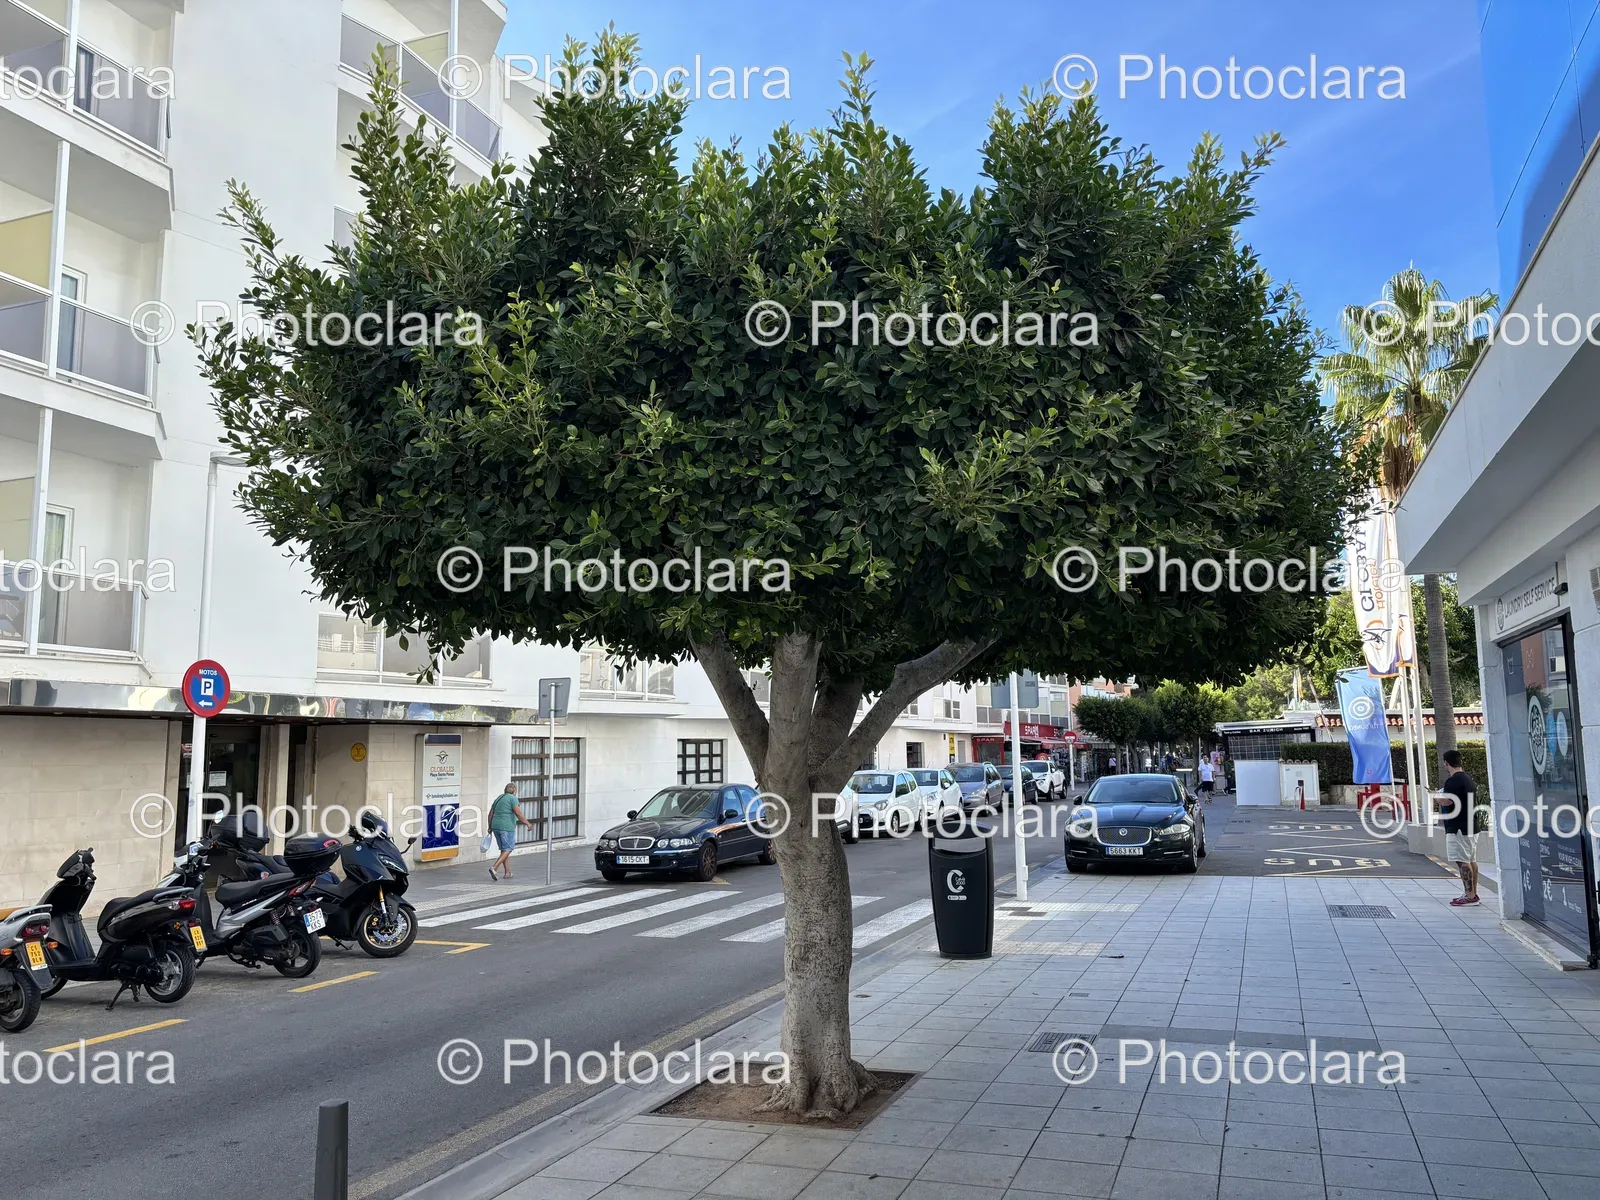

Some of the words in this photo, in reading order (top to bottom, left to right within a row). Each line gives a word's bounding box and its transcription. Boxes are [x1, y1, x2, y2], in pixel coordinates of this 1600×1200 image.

[1505, 597, 1523, 619] LAUNDRY
[1523, 588, 1534, 608] SELF
[1534, 577, 1555, 603] SERVICE
[203, 681, 212, 694] P
[1025, 725, 1036, 736] SPAR
[1110, 847, 1128, 855] 5663
[1263, 857, 1392, 867] BUS
